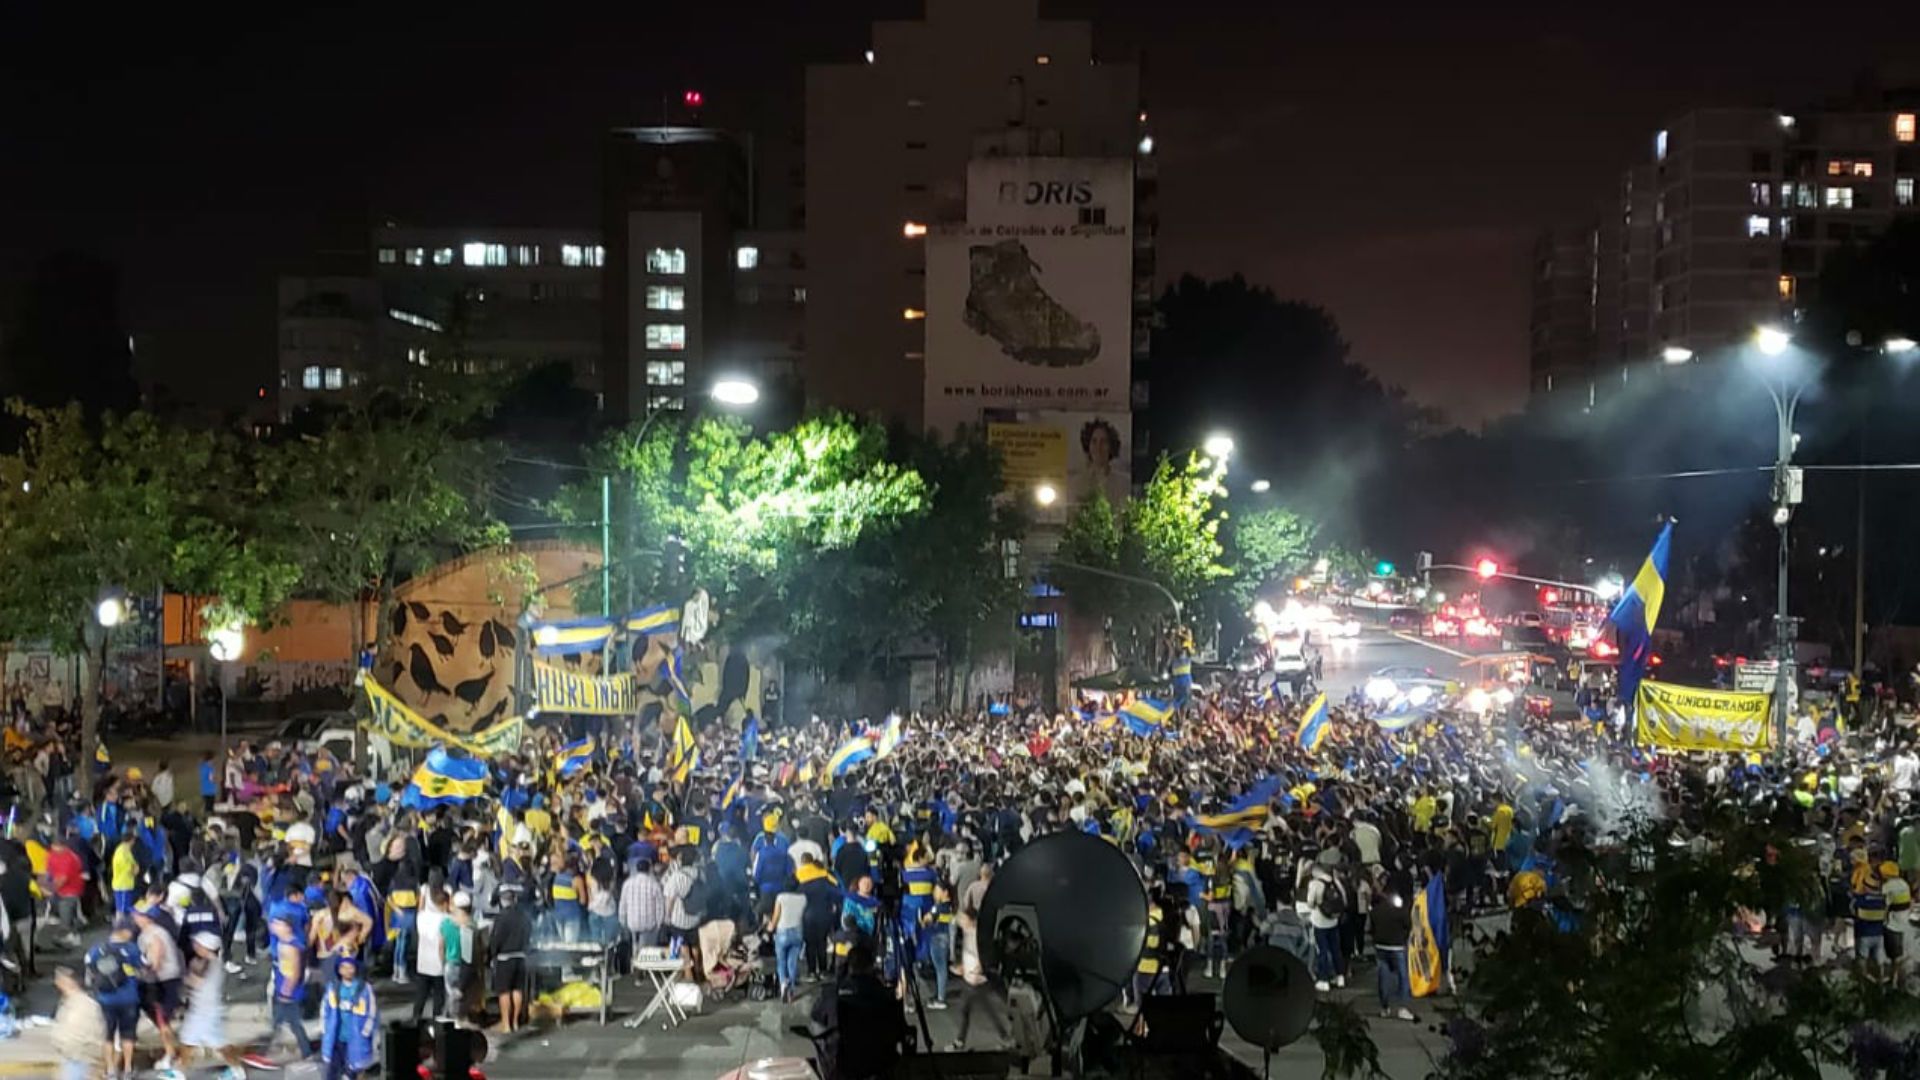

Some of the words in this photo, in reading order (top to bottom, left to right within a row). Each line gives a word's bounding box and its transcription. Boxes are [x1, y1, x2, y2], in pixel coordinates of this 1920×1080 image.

[999, 180, 1093, 205] BORIS
[1659, 690, 1673, 704] EL
[1676, 694, 1711, 709] UNICO
[1714, 699, 1764, 712] GRANDE
